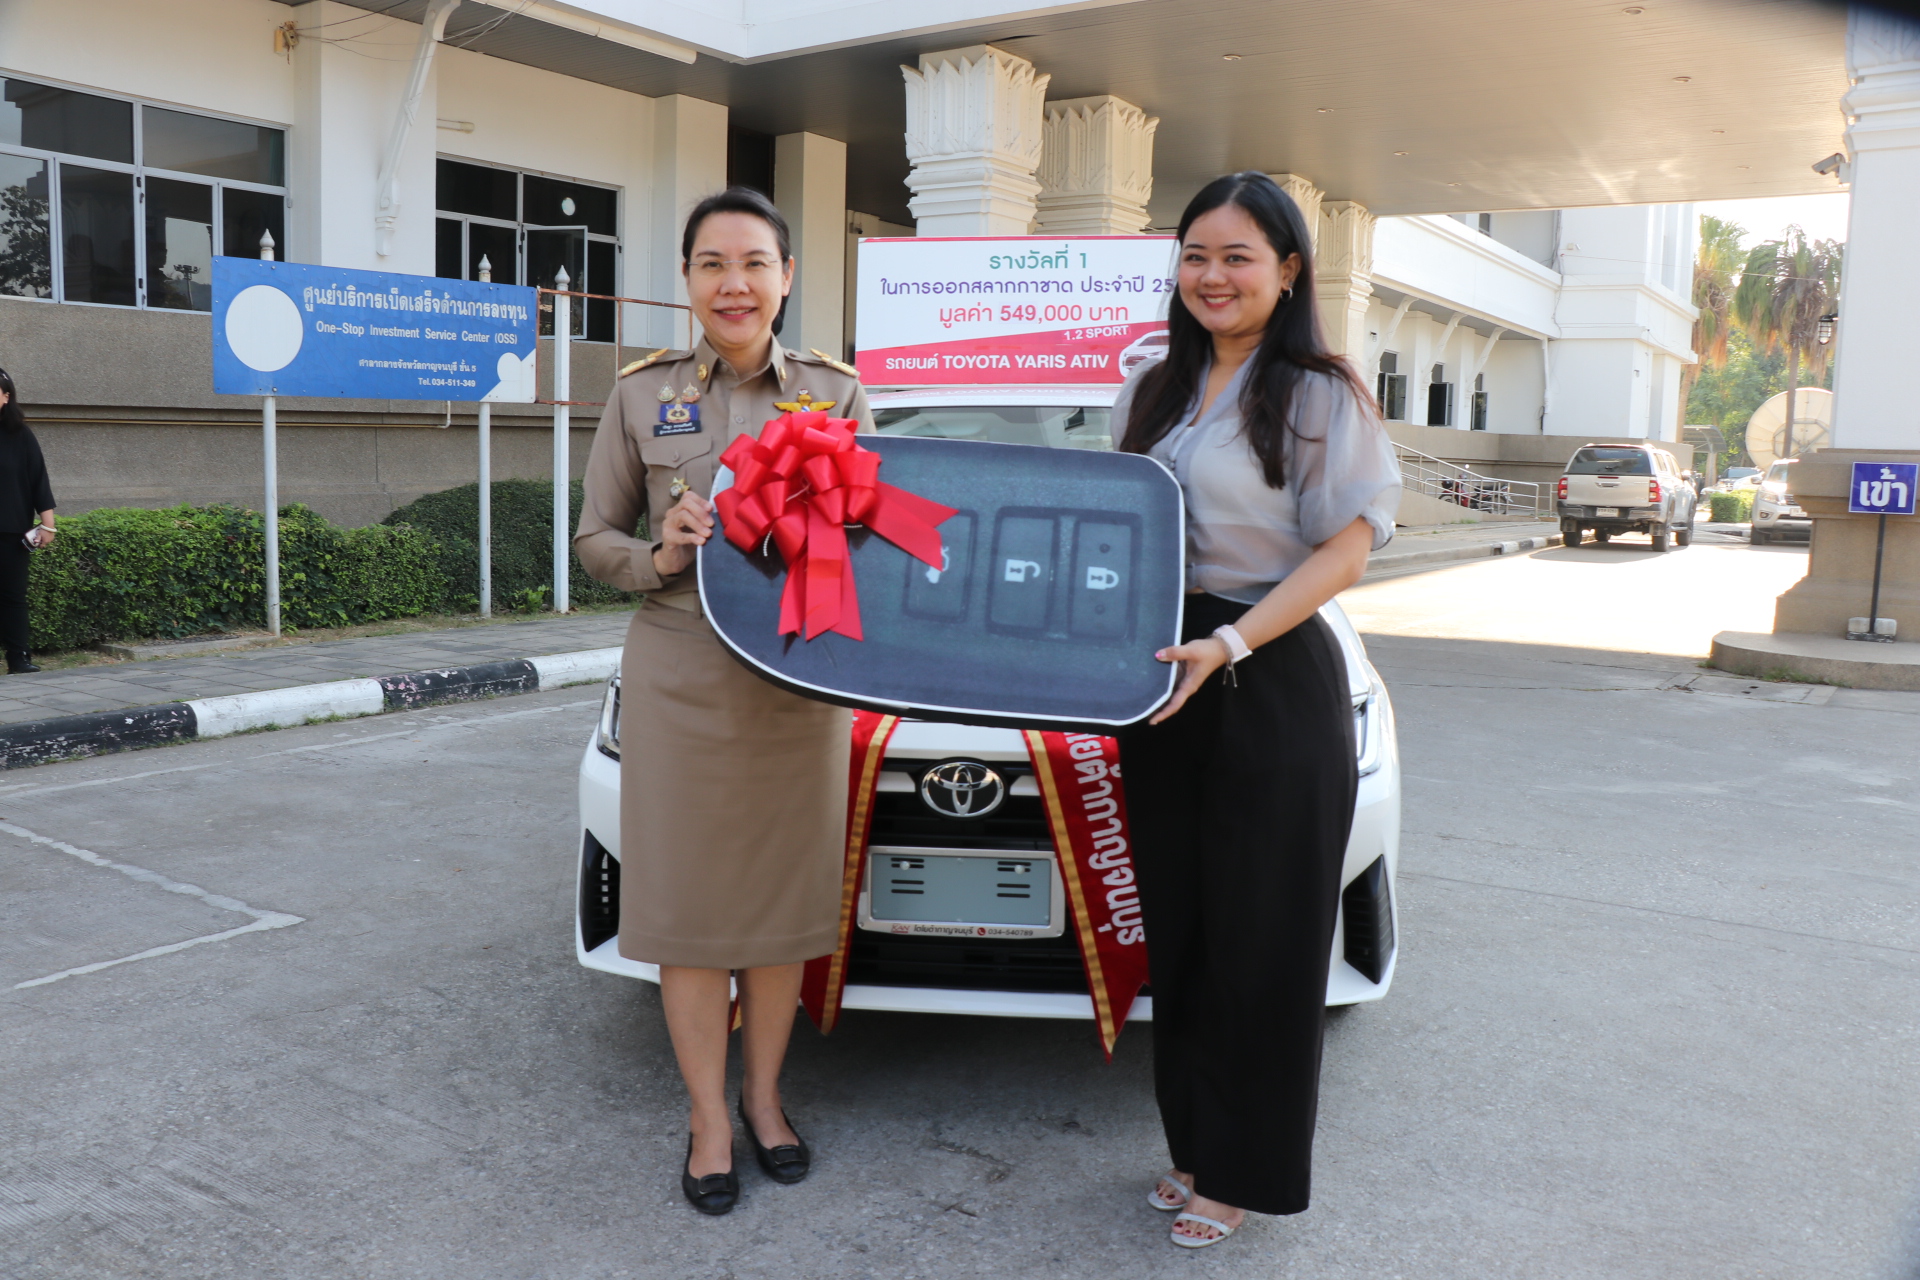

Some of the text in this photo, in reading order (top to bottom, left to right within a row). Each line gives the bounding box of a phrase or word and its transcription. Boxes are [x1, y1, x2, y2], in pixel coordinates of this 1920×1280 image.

[989, 244, 1088, 270] รางวัลที่ 1
[880, 274, 1175, 295] ในการออกสลากกาชาด ประจำปี 25
[303, 283, 528, 327] ศูนย์บริการเบ็ดเสร็จด้านการลงทุน
[939, 302, 1129, 329] มูลค่า 549,000 บาท
[316, 320, 518, 345] One-Stop Investment Service Center (OSS)
[1063, 325, 1129, 341] 1.2 SPORT
[885, 353, 1110, 370] รถยนต์ TOYOTA YARIS ATIV
[1860, 468, 1908, 508] เข้า
